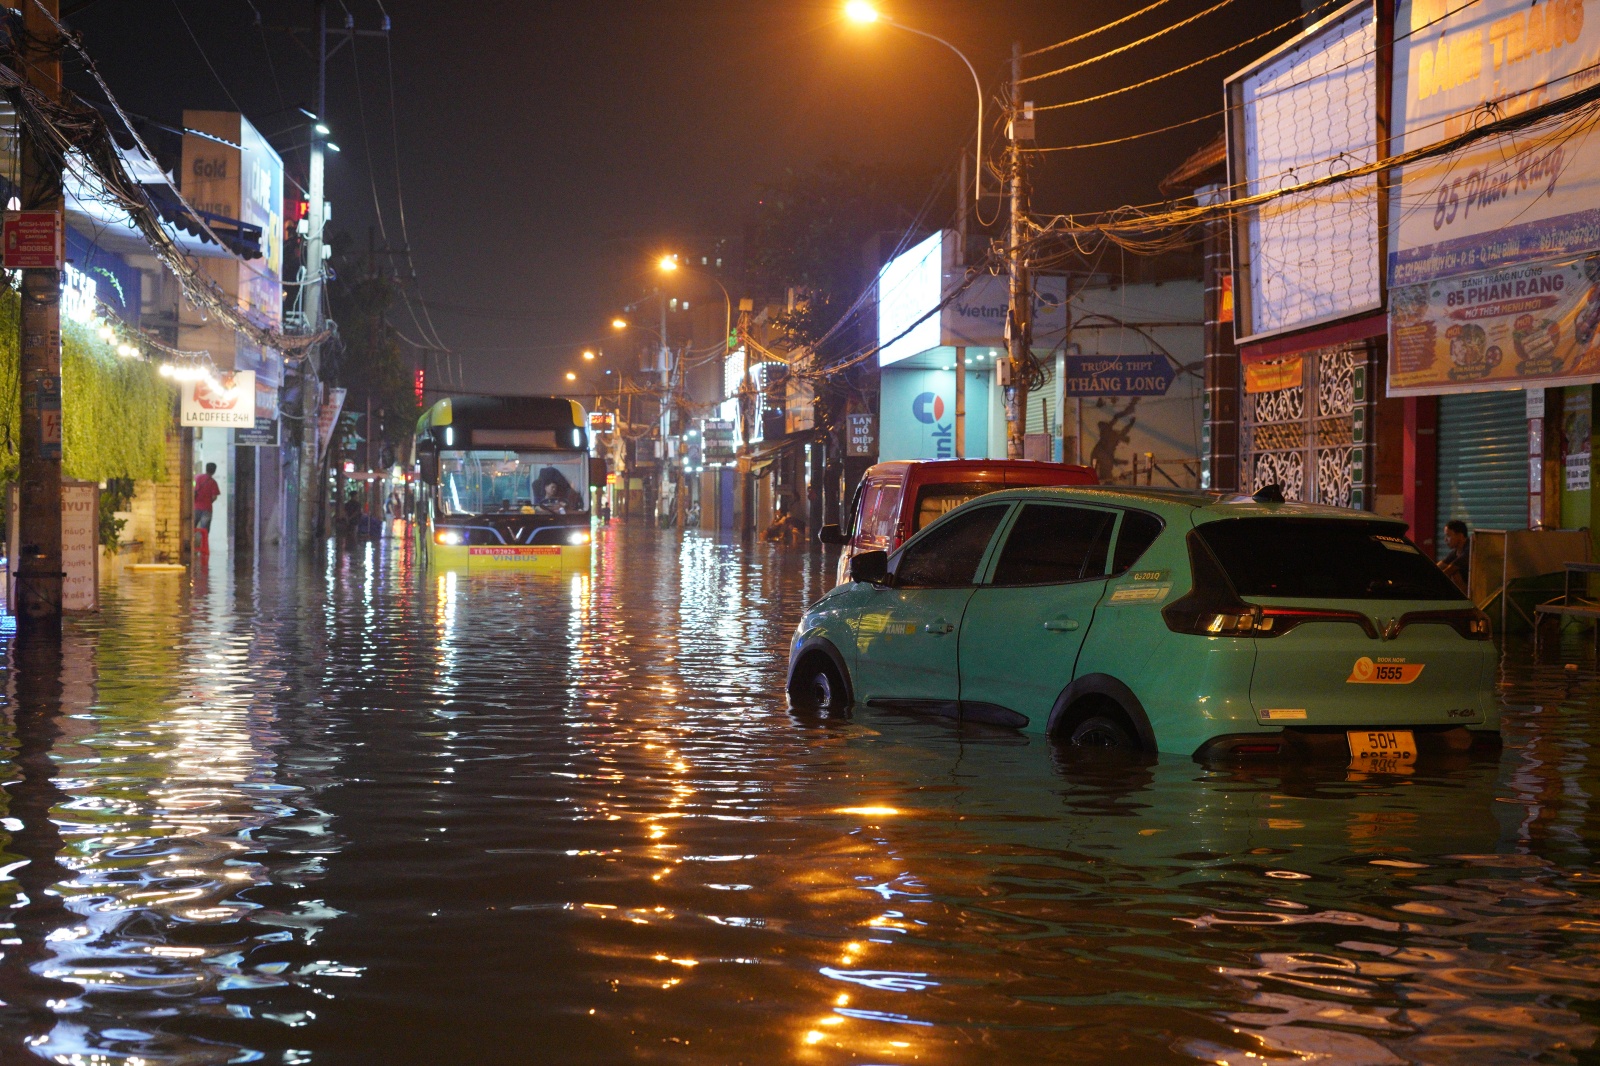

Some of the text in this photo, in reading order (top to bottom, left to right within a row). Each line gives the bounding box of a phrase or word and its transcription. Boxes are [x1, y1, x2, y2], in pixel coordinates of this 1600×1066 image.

[1419, 29, 1483, 100] BÁNH
[193, 158, 227, 178] Gold
[1433, 141, 1566, 231] 85 Phan Rang
[1462, 267, 1543, 289] BÁNH TRÁNG NƯỚNG
[1447, 274, 1564, 307] 85 PHAN RANG
[1480, 304, 1500, 316] THÊM
[1501, 301, 1523, 313] MENU
[1082, 360, 1153, 371] TRƯỜNG THPT
[1126, 376, 1166, 391] LONG
[187, 412, 249, 422] LA COFFEE 24H
[853, 417, 872, 425] LAN
[1376, 667, 1402, 680] 1555
[1368, 733, 1398, 749] 50H
